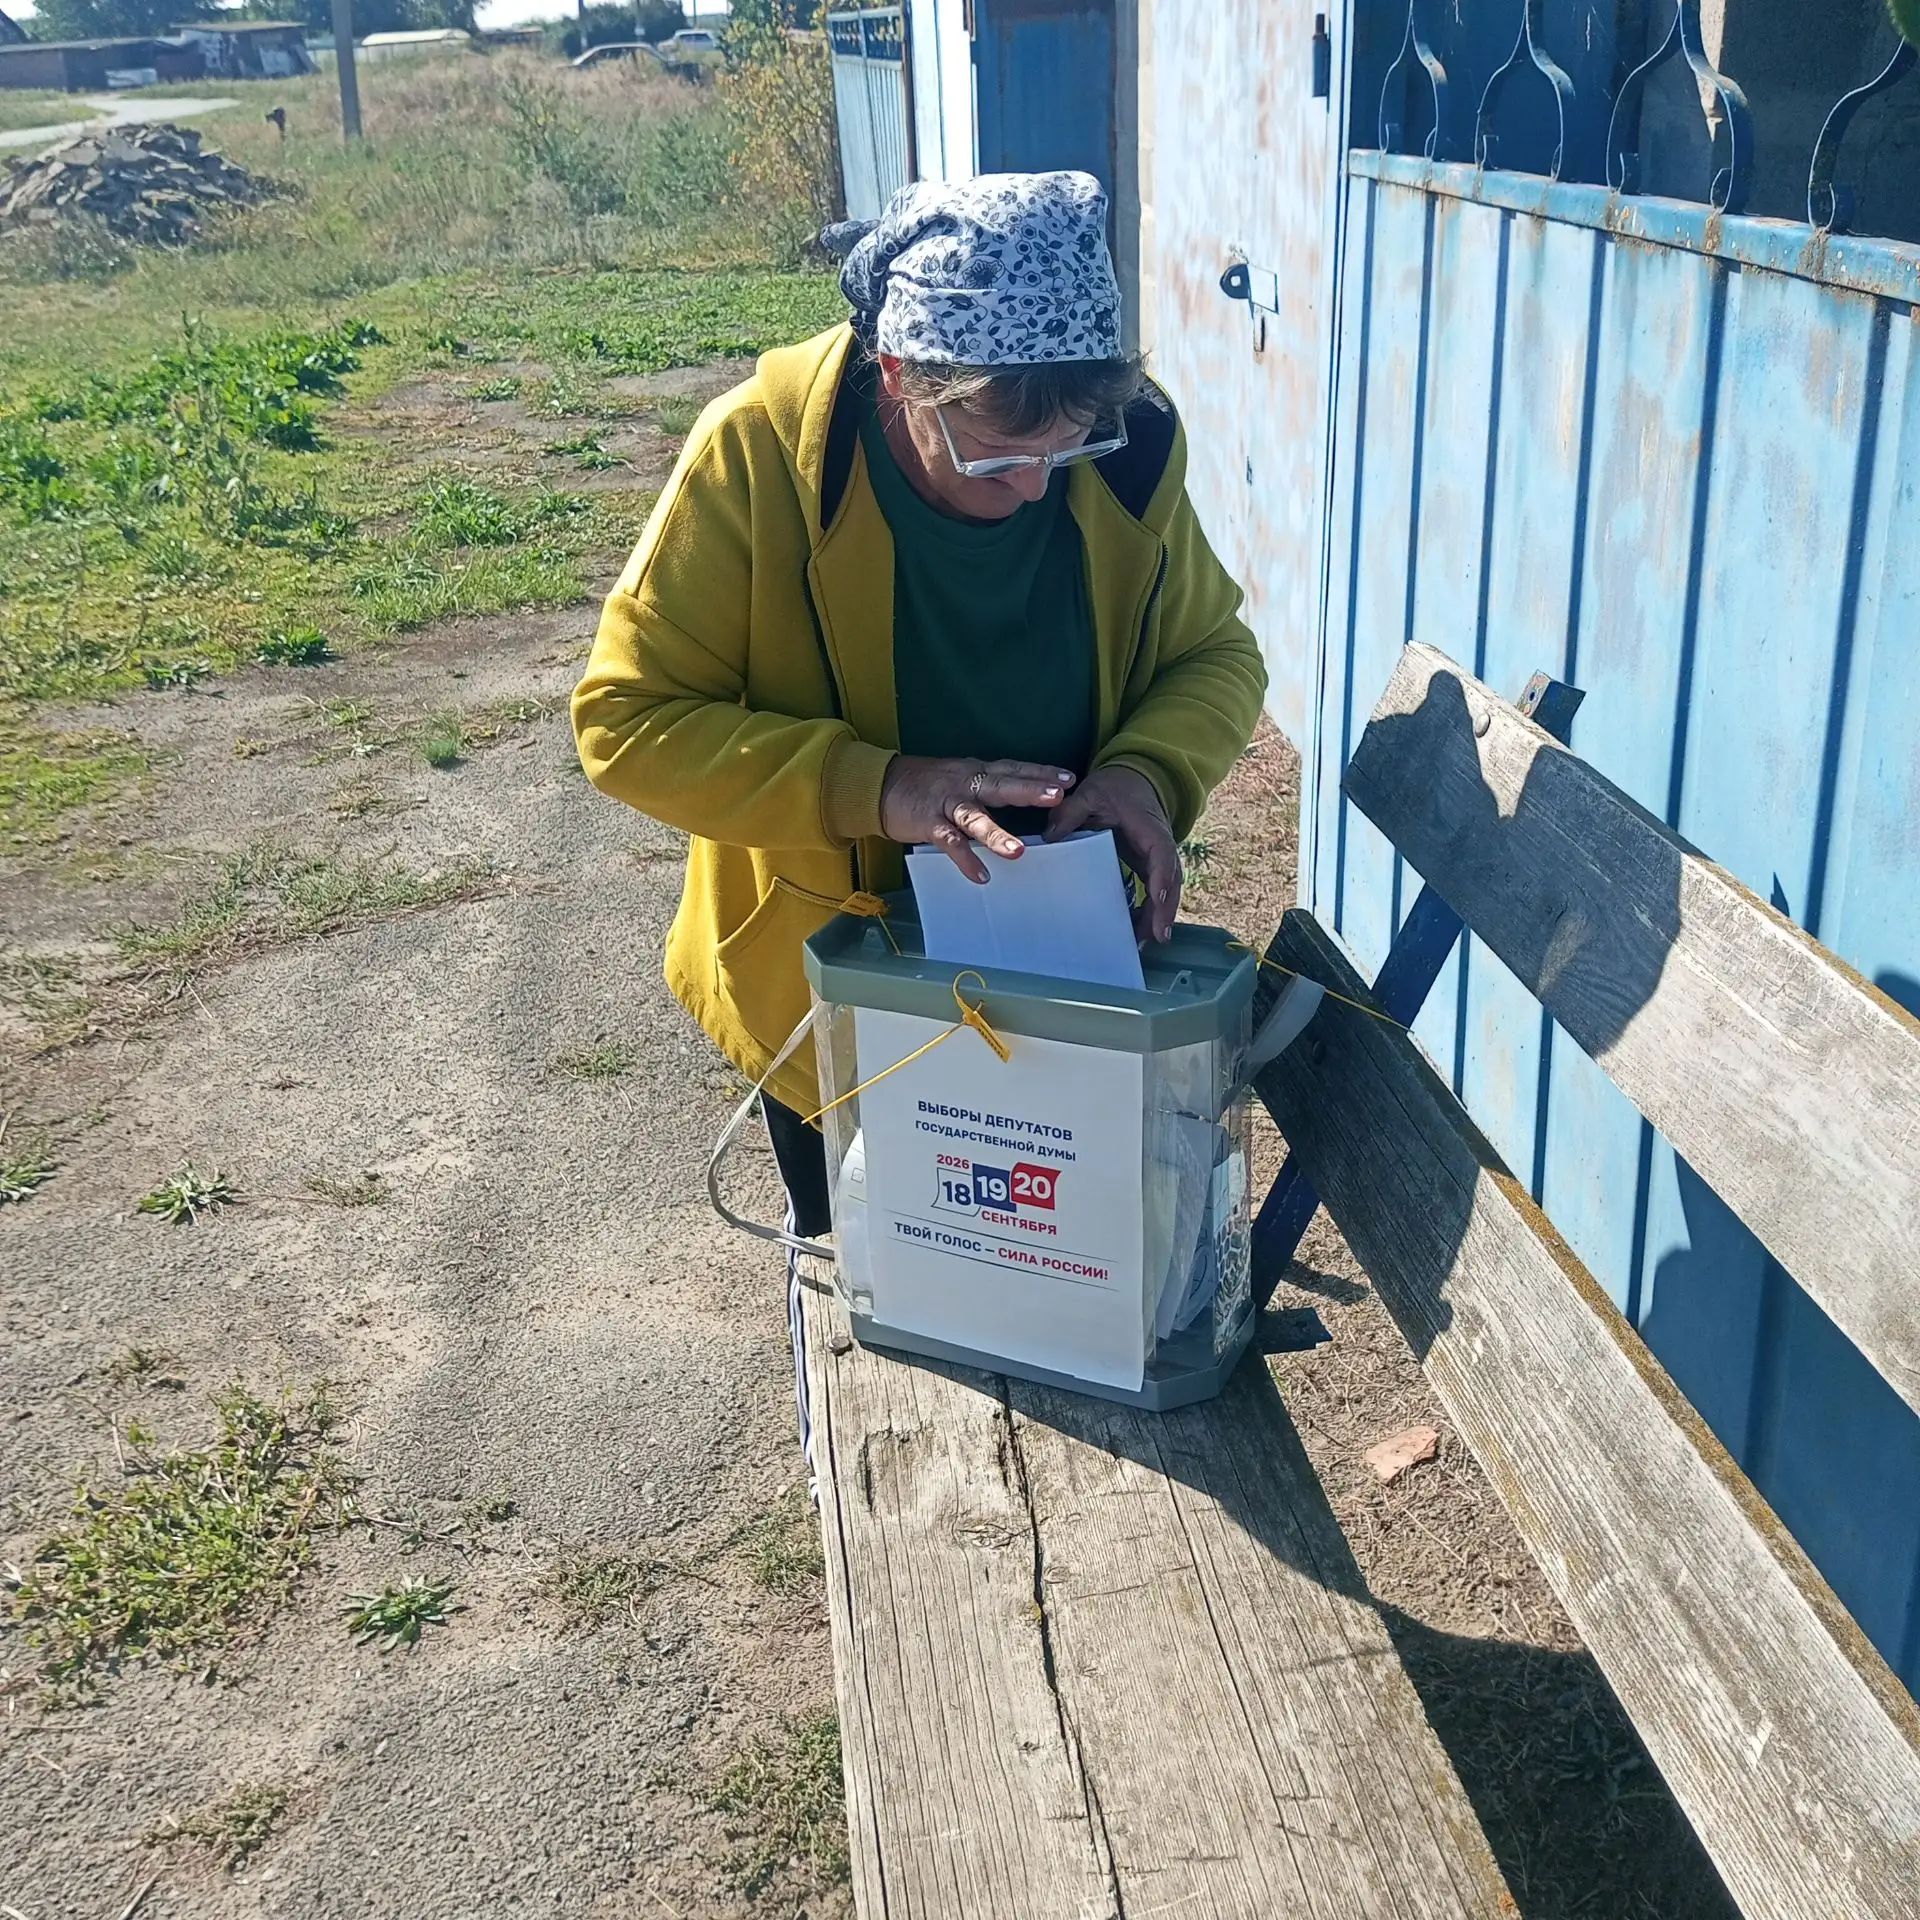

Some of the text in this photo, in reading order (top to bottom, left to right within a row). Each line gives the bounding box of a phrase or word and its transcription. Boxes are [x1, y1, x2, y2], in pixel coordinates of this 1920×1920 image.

[917, 1100, 1073, 1141] ВЫБОРЫ ДЕПУТАТОВ
[915, 1120, 1076, 1162] ГОСУДАРСТВЕННОЙ ДУМЫ
[936, 1153, 970, 1170] 2026
[942, 1171, 1052, 1206] 18 19 20
[981, 1209, 1057, 1236] СЕНТЯБРЯ
[894, 1221, 932, 1241] ТВОЙ
[935, 1232, 982, 1252] ГОЛОС
[998, 1247, 1038, 1266] СИЛА
[1042, 1257, 1109, 1281] РОССИИ!
